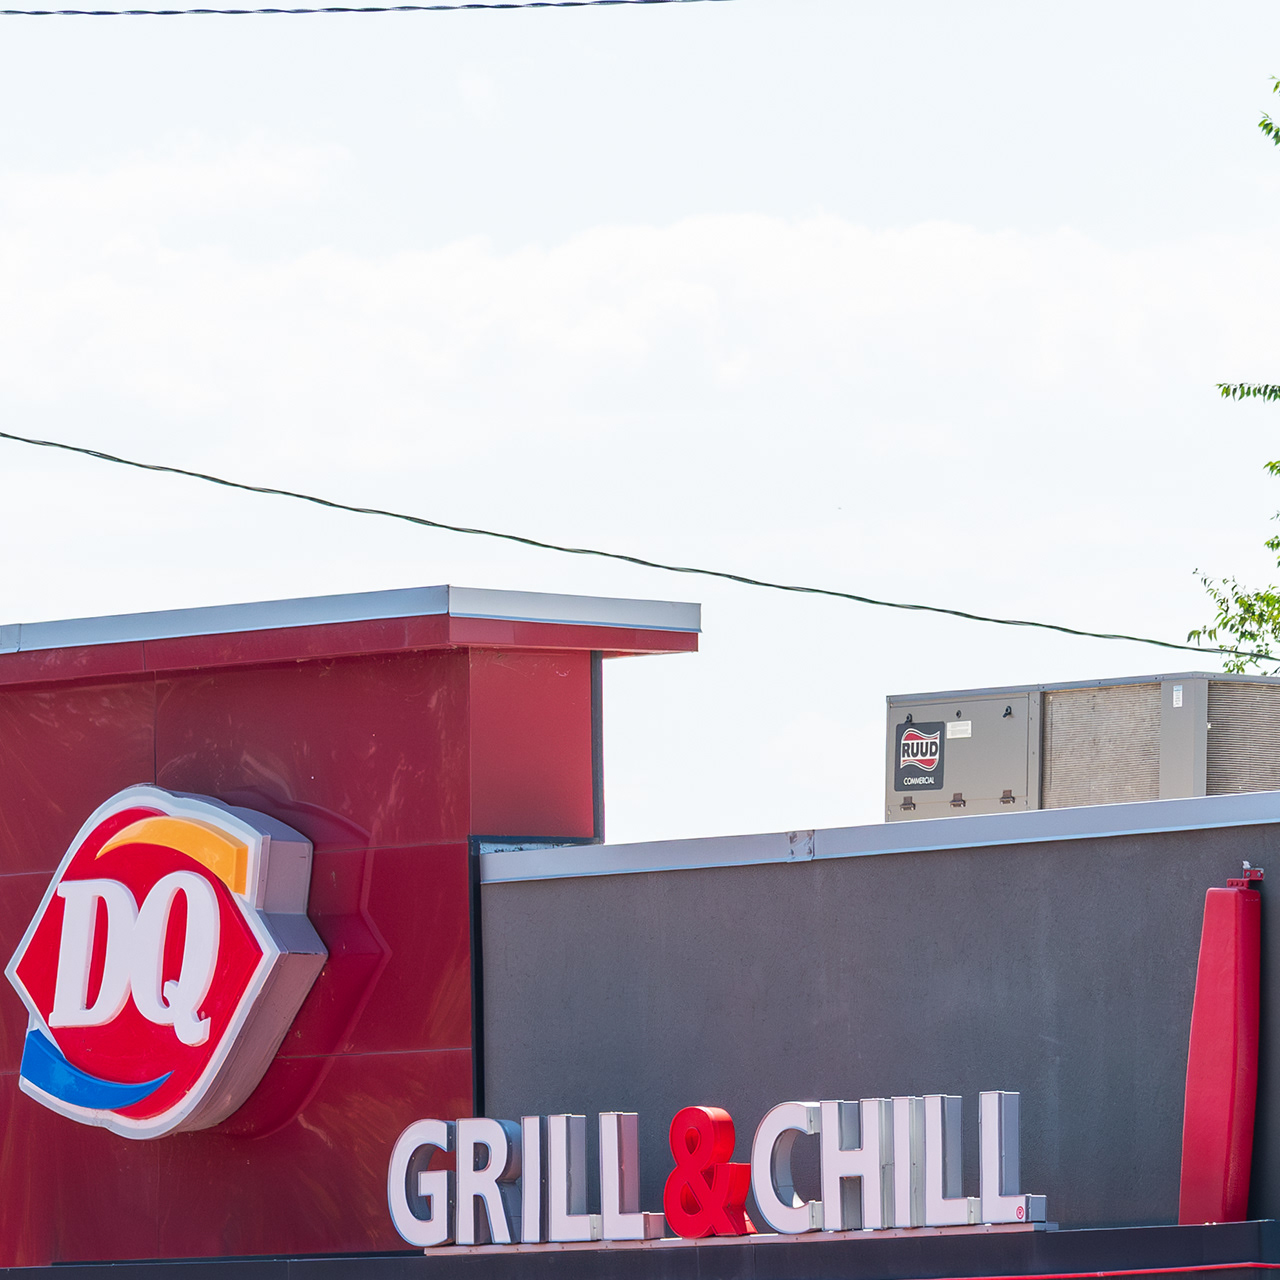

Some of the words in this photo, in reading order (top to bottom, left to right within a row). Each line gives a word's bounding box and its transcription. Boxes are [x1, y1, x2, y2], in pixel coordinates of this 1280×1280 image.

[902, 741, 938, 758] RUUD
[903, 776, 935, 786] COMMERCIAL
[48, 870, 221, 1046] DQ
[387, 1111, 664, 1248] GRILL
[663, 1105, 752, 1239] &
[751, 1091, 1046, 1235] CHILL
